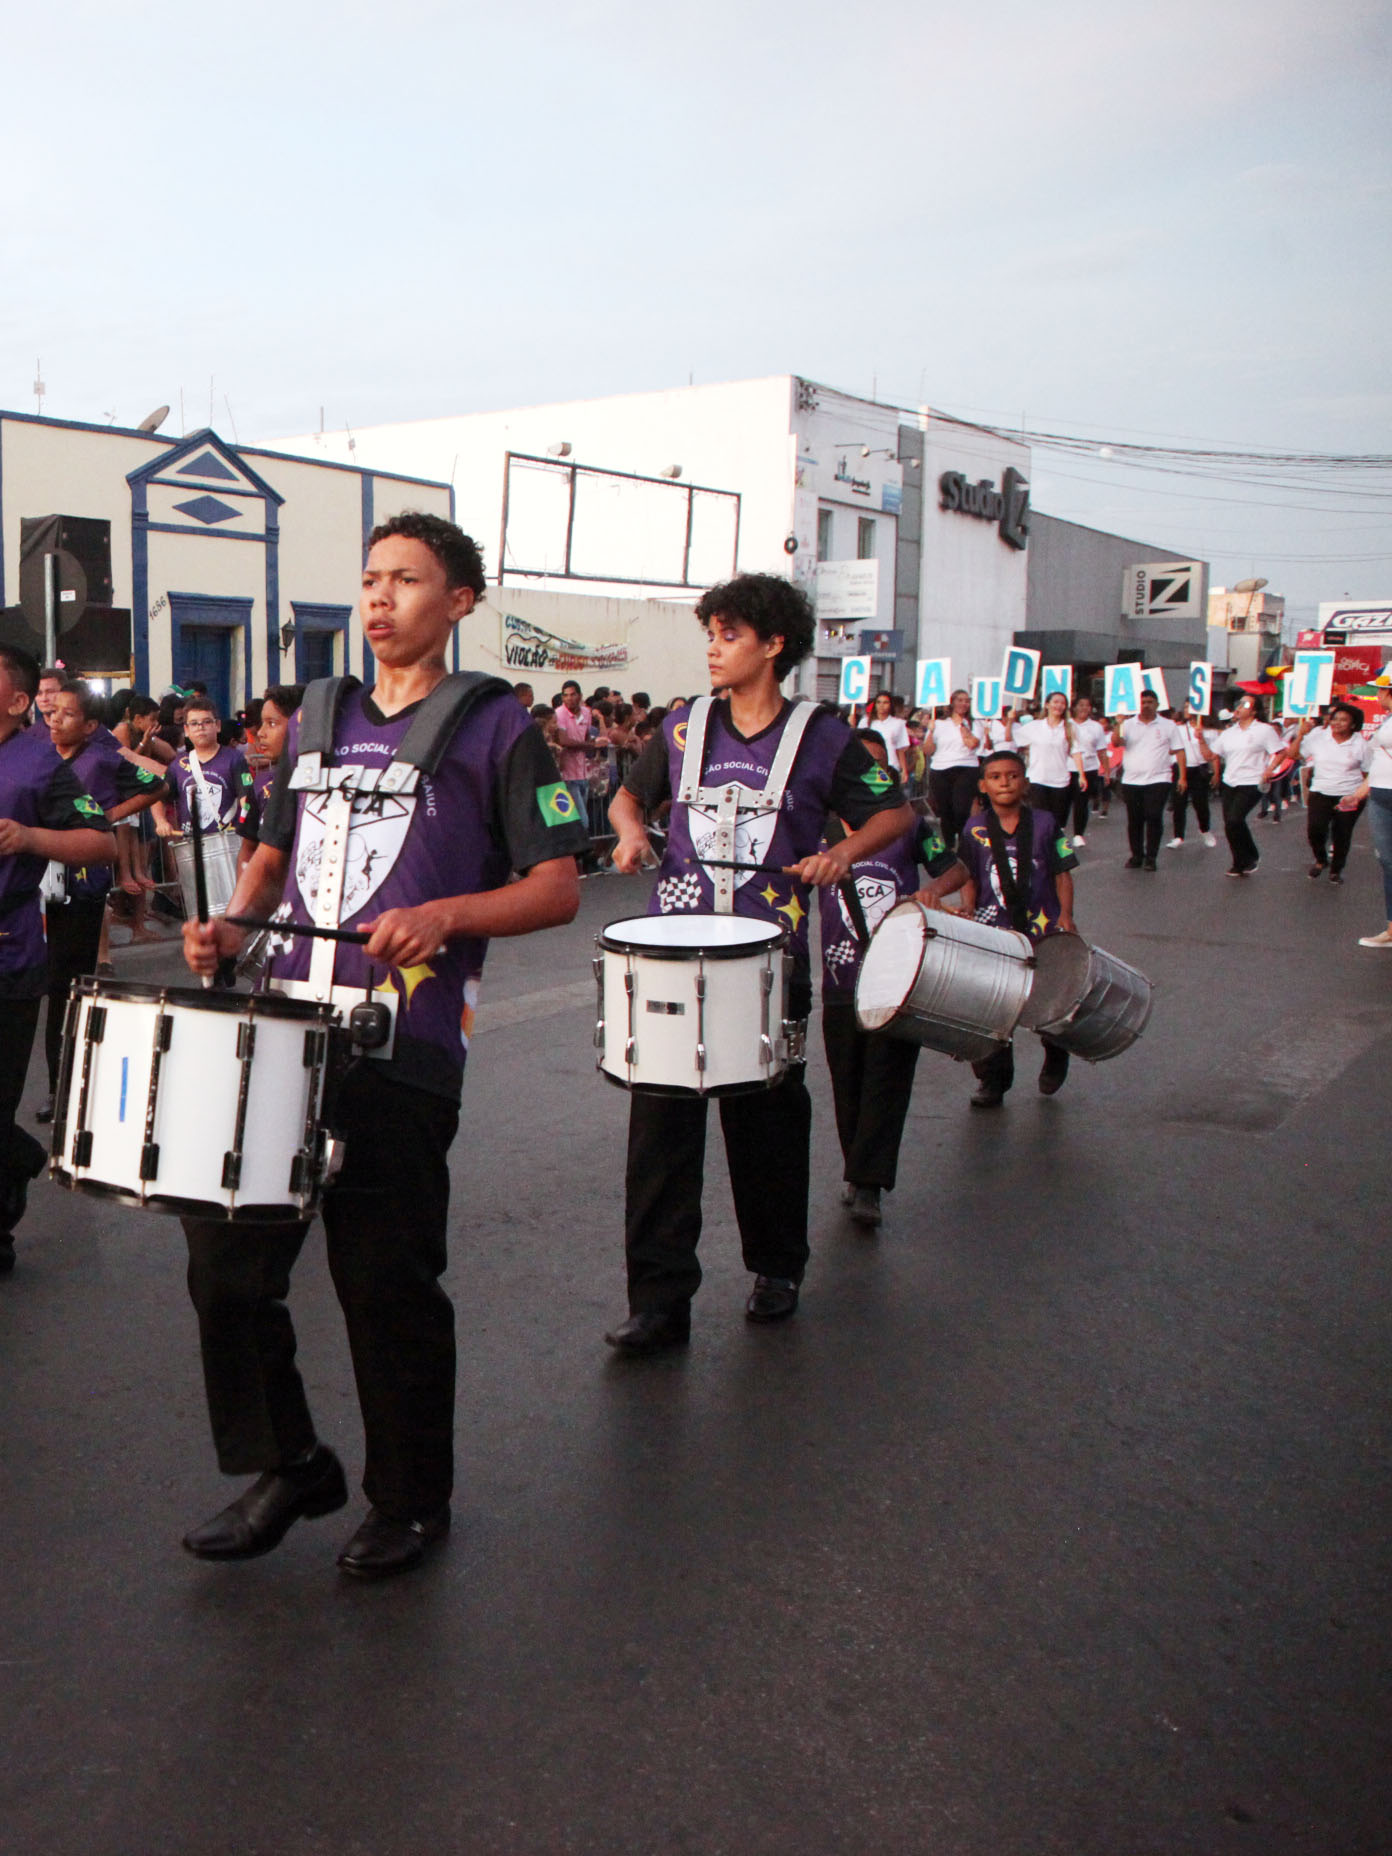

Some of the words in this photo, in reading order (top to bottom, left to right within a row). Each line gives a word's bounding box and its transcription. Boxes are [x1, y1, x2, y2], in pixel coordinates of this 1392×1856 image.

[1135, 570, 1146, 615] STUDIO
[843, 660, 864, 700] C
[919, 662, 946, 704] A
[1004, 651, 1034, 694] D
[1108, 667, 1136, 712] A
[1189, 666, 1206, 712] S
[1298, 655, 1333, 702] T
[978, 681, 1000, 717] U
[351, 743, 391, 756] SOCIAL
[723, 761, 755, 772] SOCIAL
[858, 885, 885, 900] SCA
